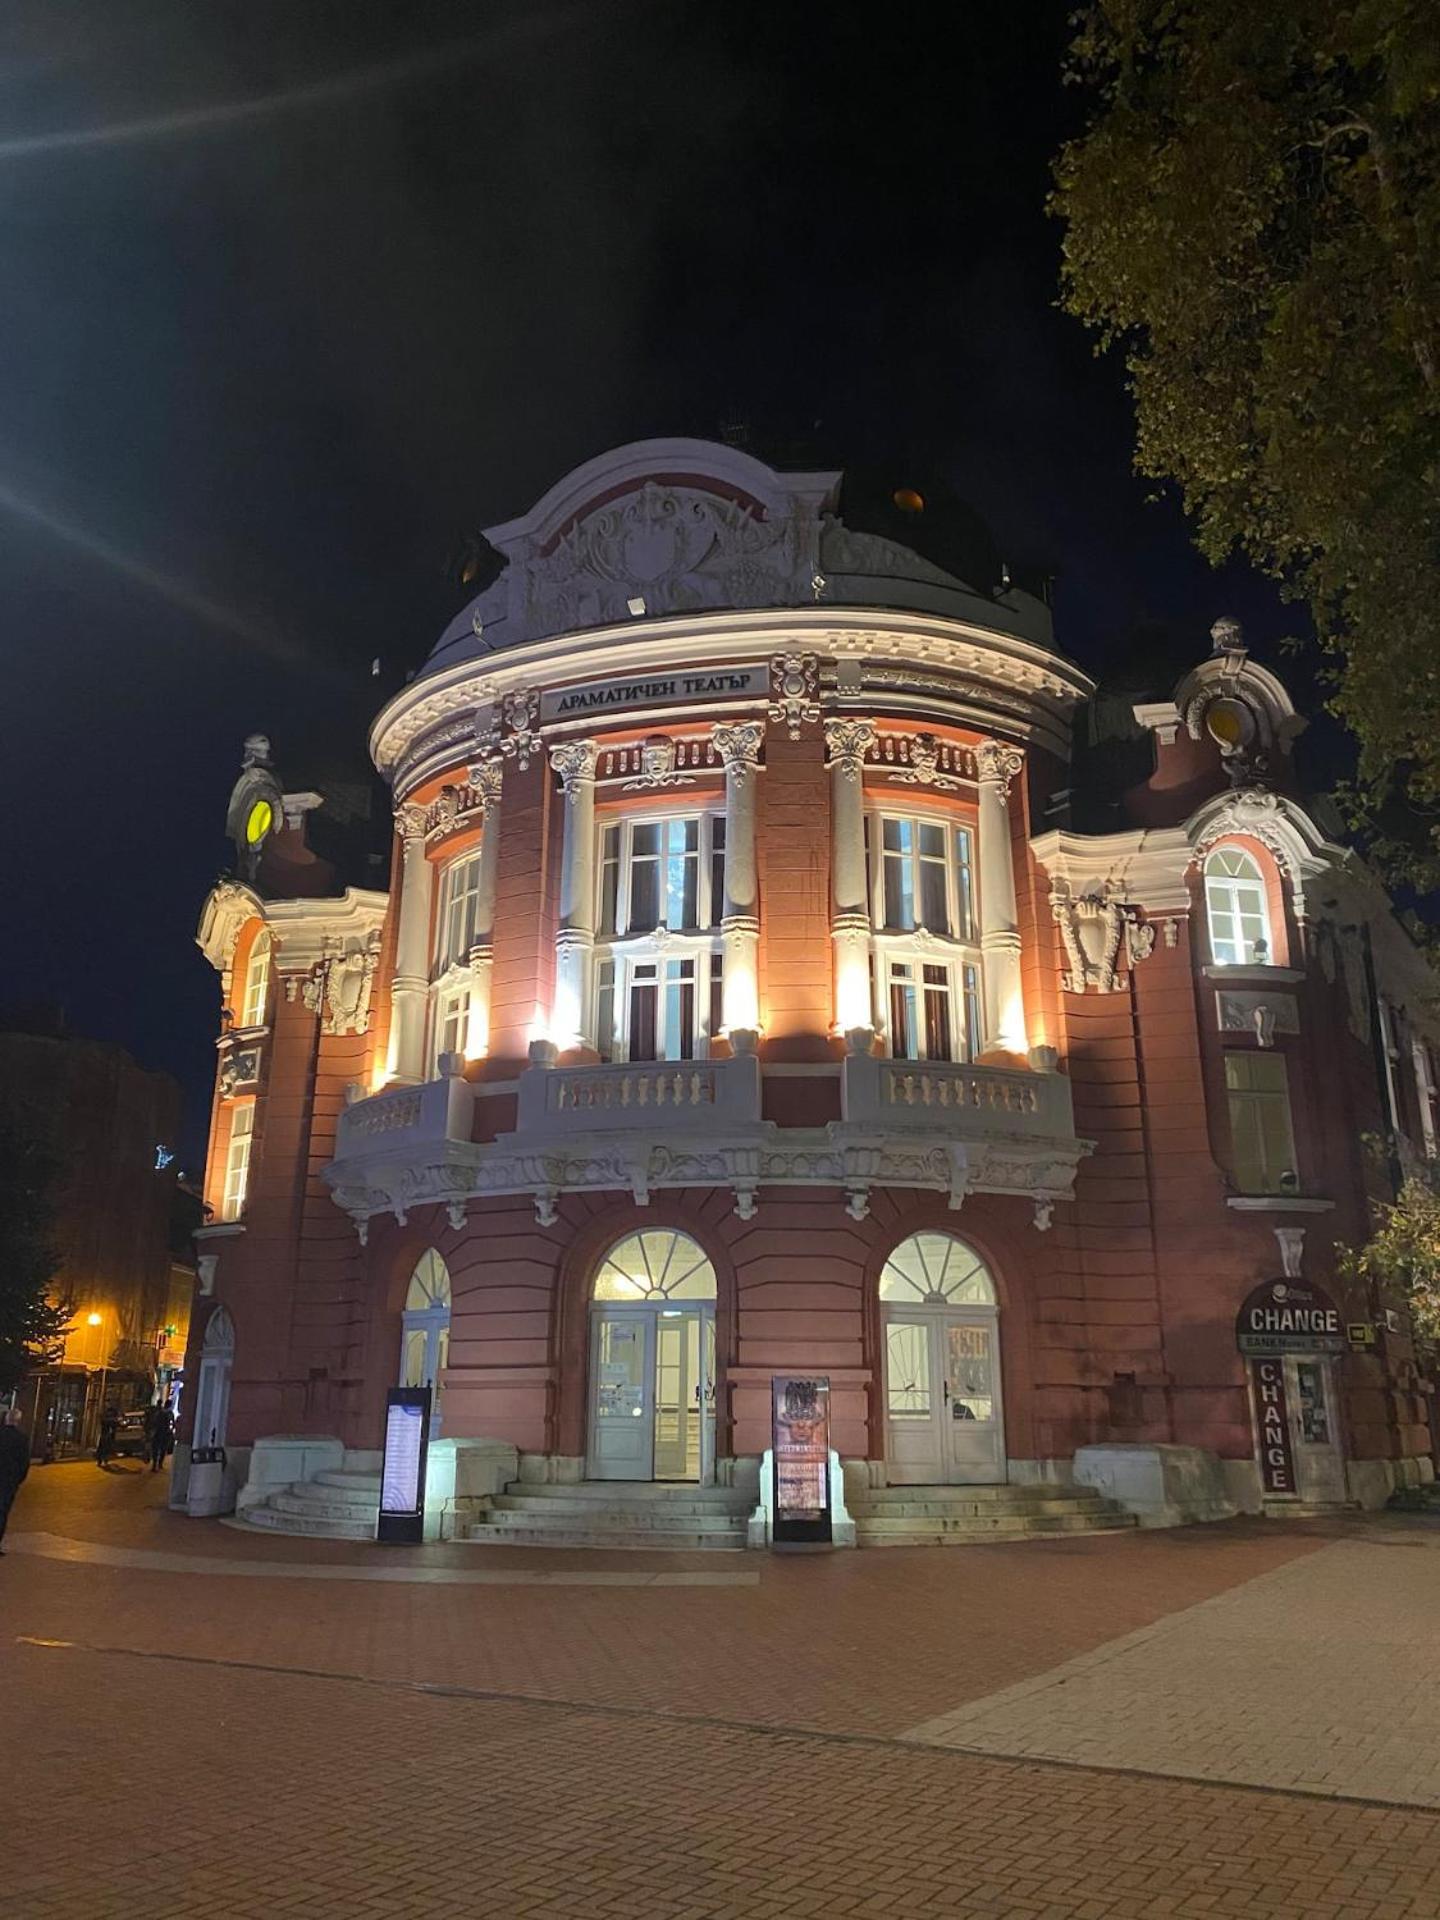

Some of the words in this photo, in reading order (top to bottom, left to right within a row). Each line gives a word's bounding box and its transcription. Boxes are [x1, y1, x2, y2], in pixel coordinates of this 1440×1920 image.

[557, 681, 676, 713] ДРАМАТИЧЕН
[683, 674, 751, 694] ТЕАТЪР
[1250, 1308, 1339, 1332] CHANGE
[1260, 1364, 1287, 1488] CHANGE
